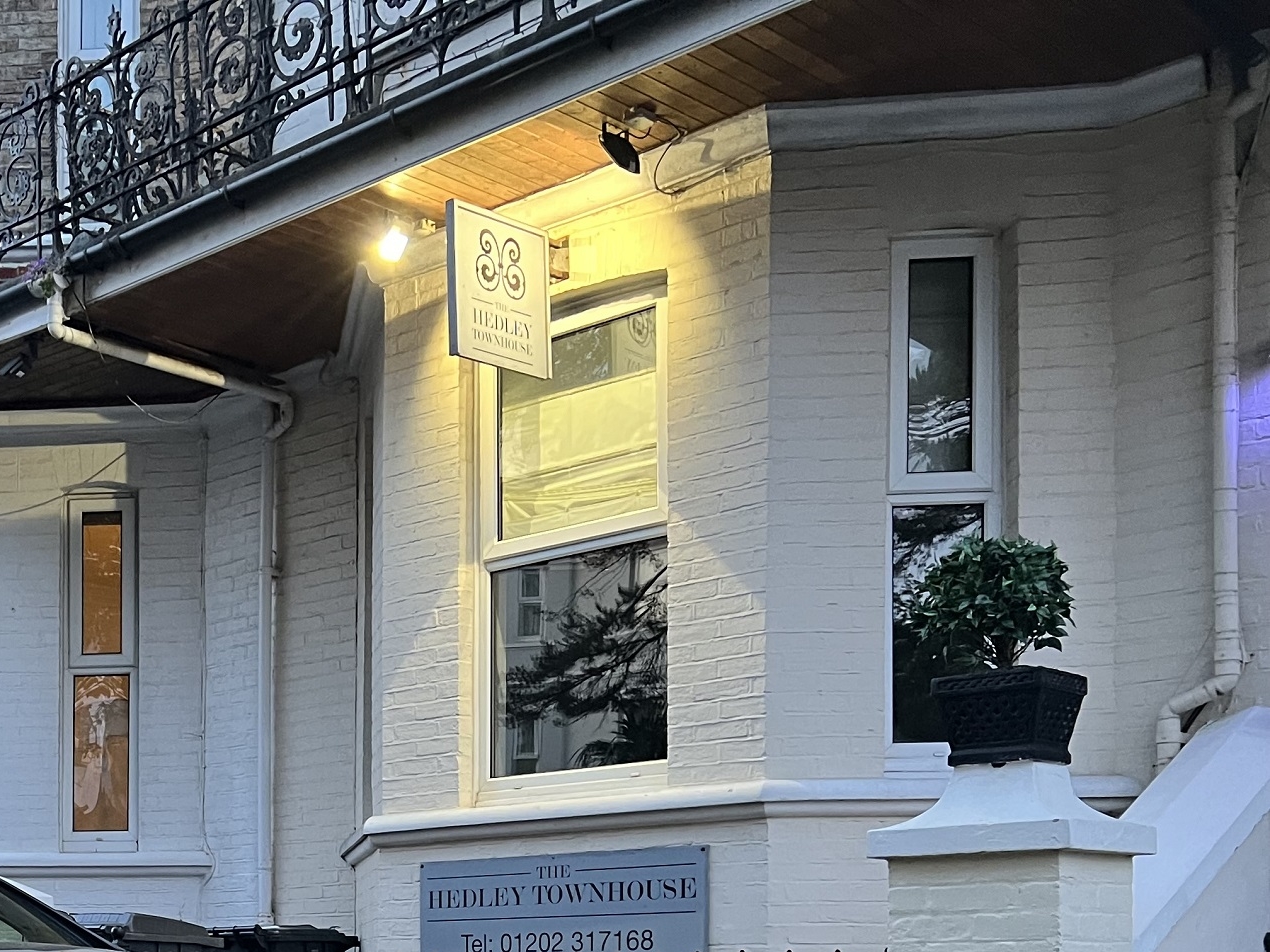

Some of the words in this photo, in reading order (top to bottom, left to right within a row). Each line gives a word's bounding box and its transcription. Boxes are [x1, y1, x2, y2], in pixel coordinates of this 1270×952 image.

[495, 301, 509, 312] THE
[472, 307, 532, 339] HEDLEY
[471, 328, 533, 356] TOWNHOUSE
[536, 864, 571, 879] THE
[428, 885, 526, 909] HEDLEY
[532, 877, 697, 905] TOWNHOUSE
[500, 932, 563, 952] 01202
[571, 929, 654, 952] 317168
